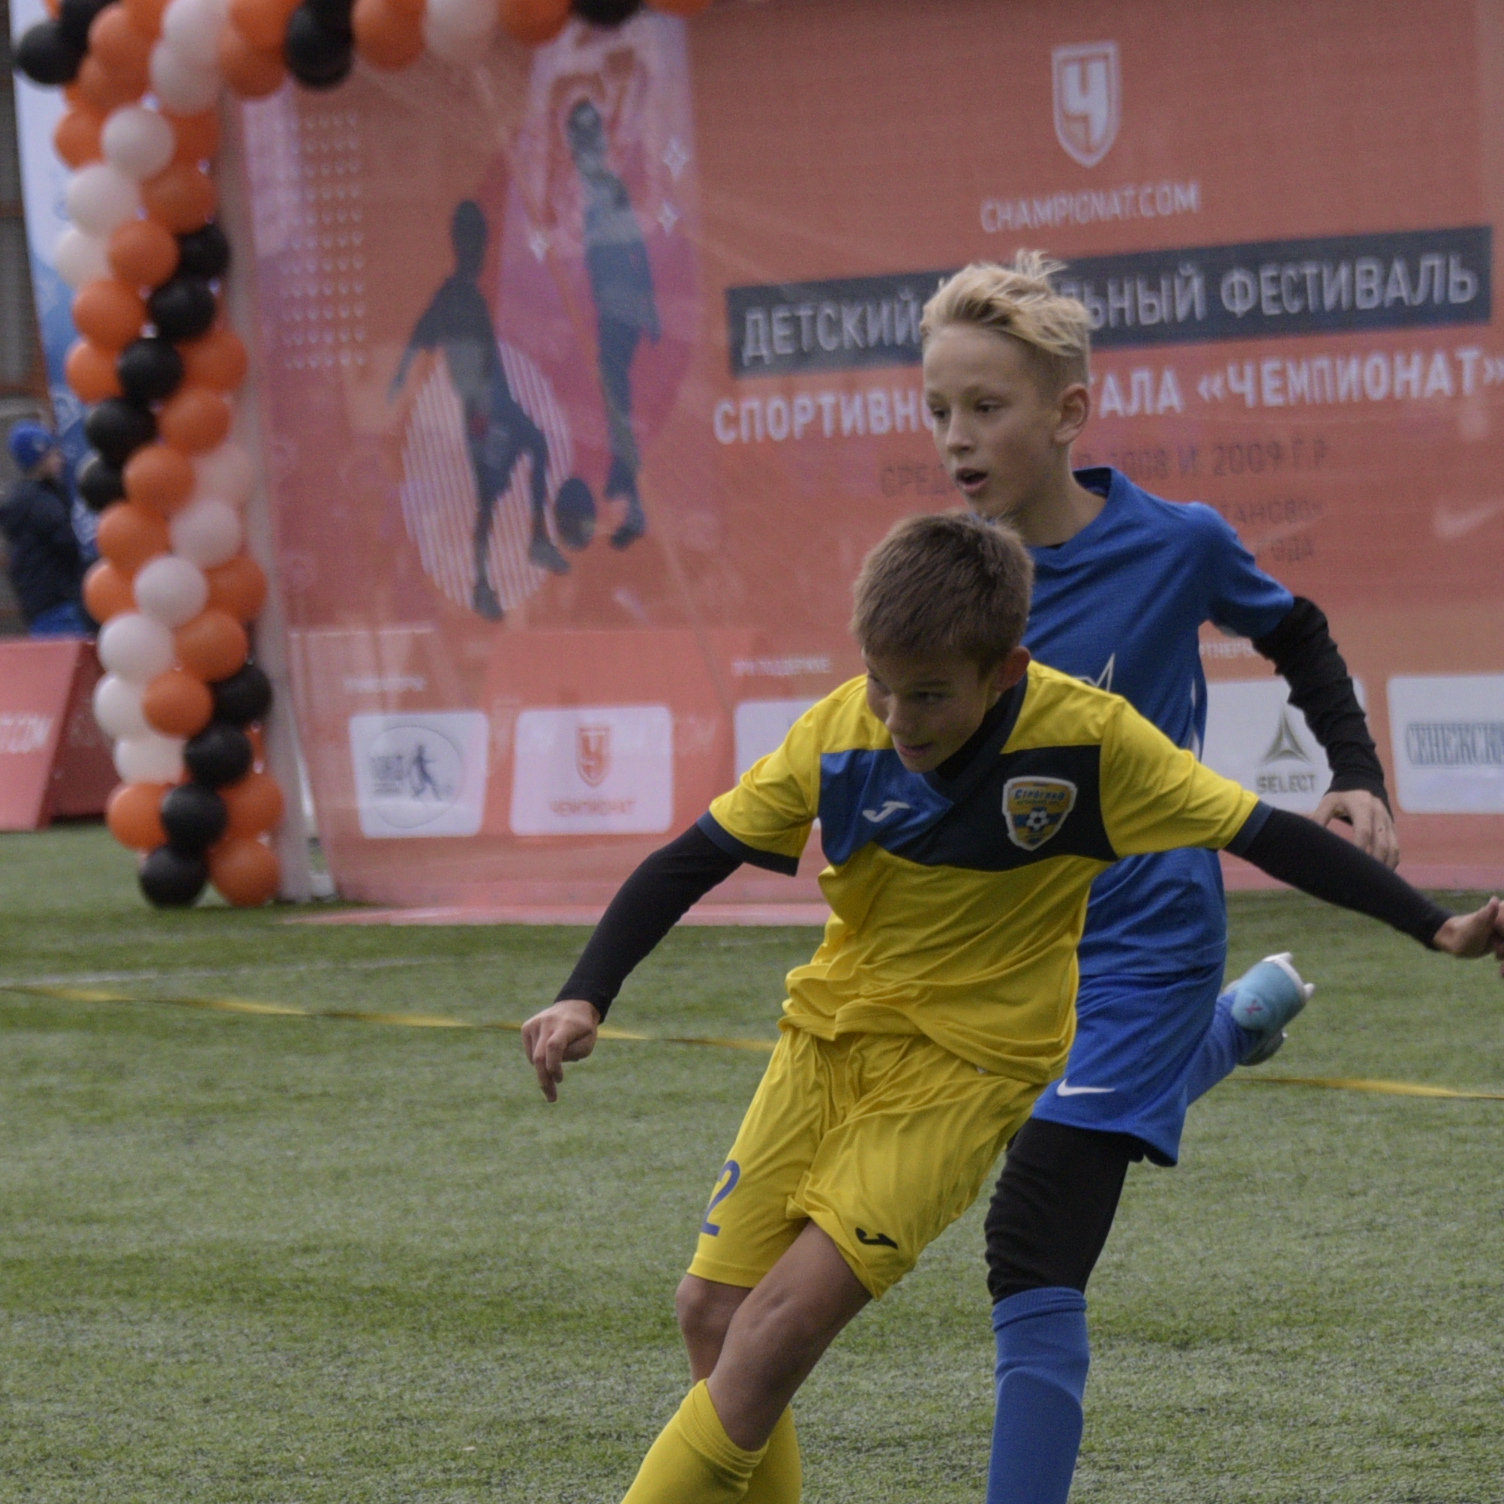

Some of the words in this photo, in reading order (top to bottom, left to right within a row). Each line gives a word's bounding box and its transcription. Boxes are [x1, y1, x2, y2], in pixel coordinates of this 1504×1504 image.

[980, 181, 1202, 233] CHAMPIONAT.COM
[742, 288, 921, 366] ДЕТСКИЙ
[1220, 250, 1479, 318] ФЕСТИВАЛЬ
[713, 385, 936, 444] СПОРТИВН
[1256, 773, 1316, 795] SELECT
